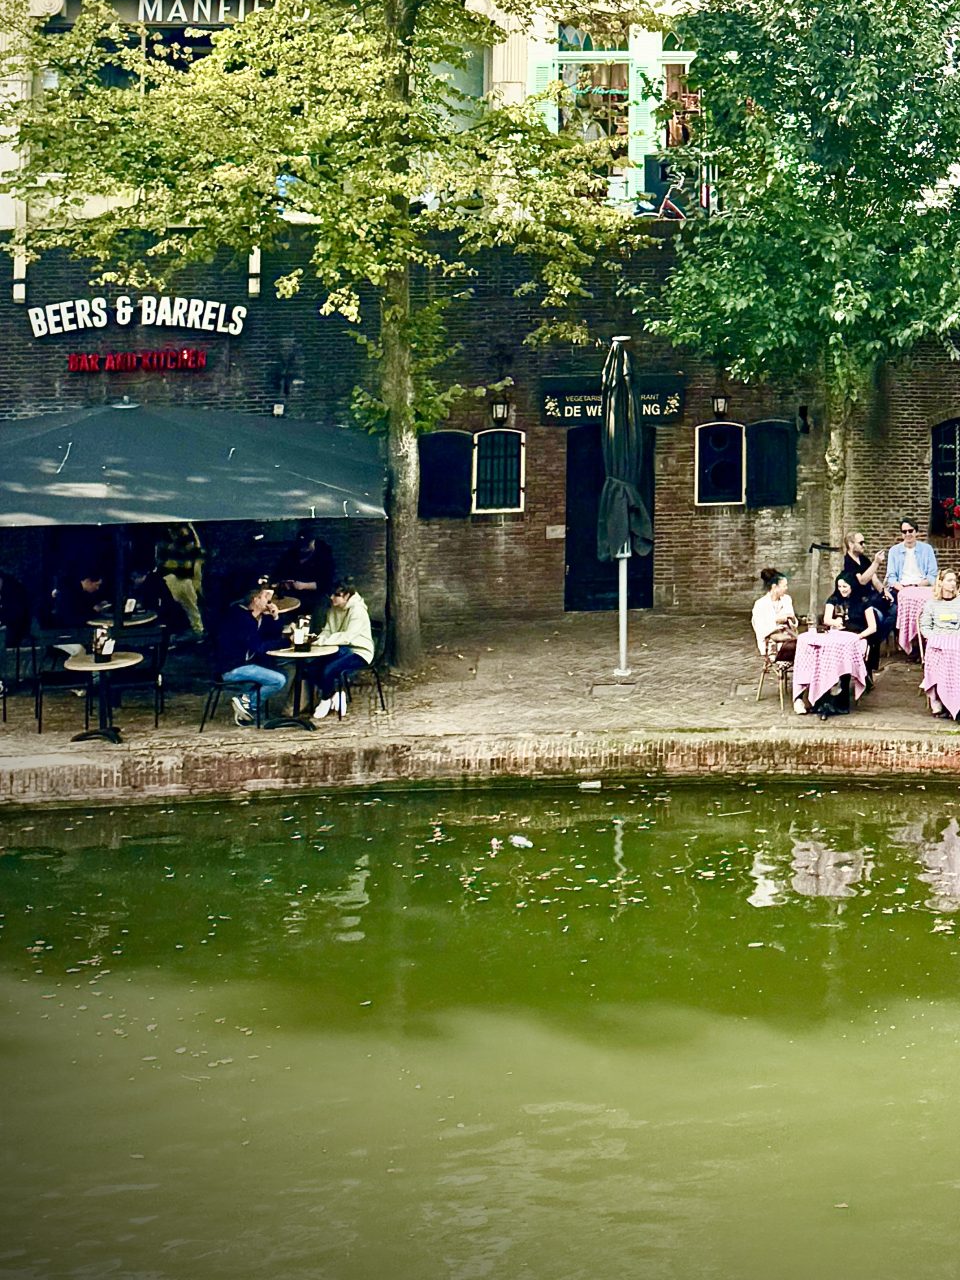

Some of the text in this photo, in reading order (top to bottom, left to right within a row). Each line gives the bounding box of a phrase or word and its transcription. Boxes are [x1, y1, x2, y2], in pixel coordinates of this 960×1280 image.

[28, 295, 247, 338] BEERS & BARRELS
[67, 348, 207, 371] BAR AND KITCHEN
[564, 406, 582, 417] DE
